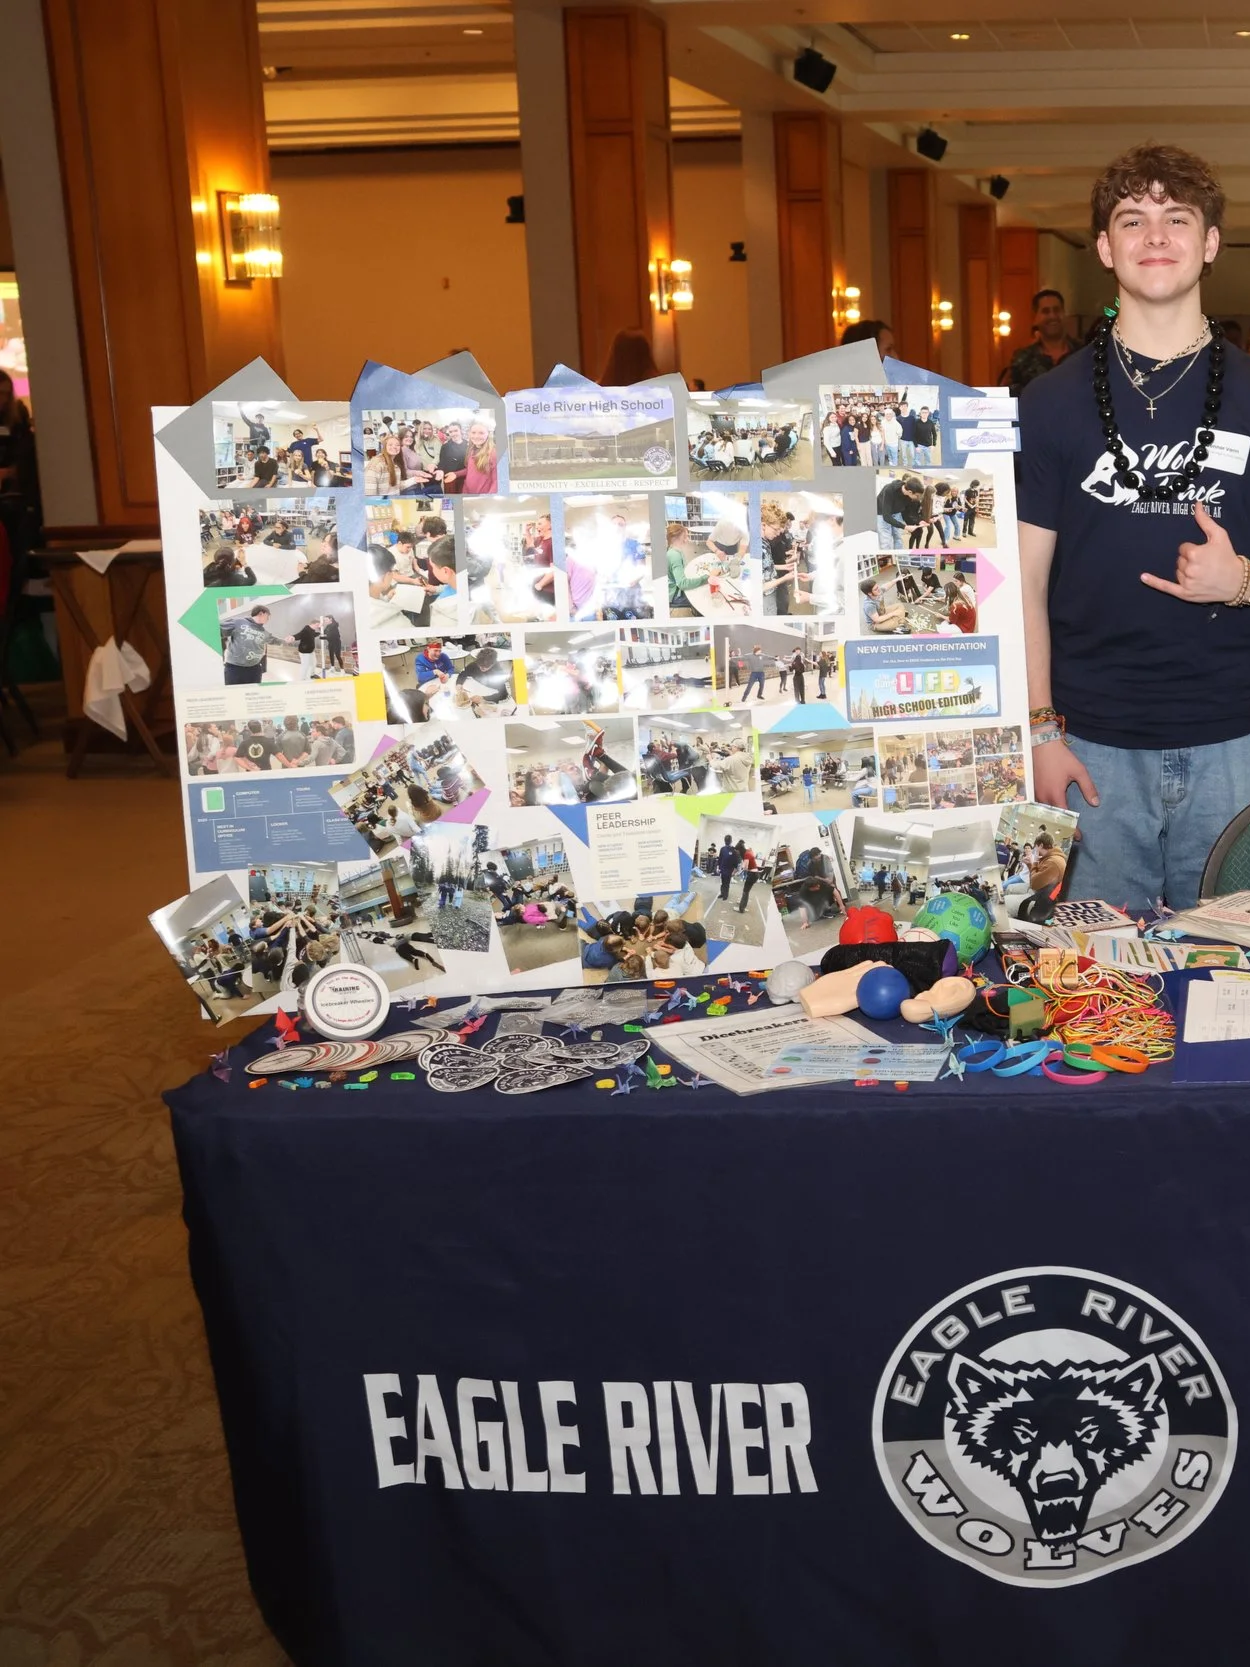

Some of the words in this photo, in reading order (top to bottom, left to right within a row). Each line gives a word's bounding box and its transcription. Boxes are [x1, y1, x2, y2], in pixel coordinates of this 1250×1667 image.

[515, 401, 551, 415] Eagle
[554, 401, 586, 412] River
[589, 400, 618, 413] High
[621, 399, 664, 411] School
[517, 481, 569, 489] COMMUNITY
[575, 480, 628, 488] EXCELLENCE
[633, 479, 670, 487] RESPECT
[1131, 502, 1150, 514] EAGLE
[1150, 501, 1170, 514] RIVER
[1172, 502, 1189, 515] HIGH
[1213, 506, 1223, 518] AK
[857, 645, 879, 654] NEW
[880, 643, 924, 653] STUDENT
[926, 642, 987, 652] ORIENTATION
[899, 672, 955, 692] LIFE
[872, 704, 897, 718] HIGH
[899, 699, 936, 714] SCHOOL
[938, 693, 977, 709] EDITION
[596, 812, 621, 820] PEER
[597, 818, 656, 830] LEADERSHIP
[699, 1017, 810, 1042] Dicebreakers
[434, 1050, 462, 1061] EAGLE
[891, 1284, 1036, 1407] EAGLE
[1080, 1289, 1213, 1407] RIVER
[363, 1373, 586, 1493] EAGLE
[601, 1380, 819, 1496] RIVER
[901, 1448, 1213, 1571] WOLVES
